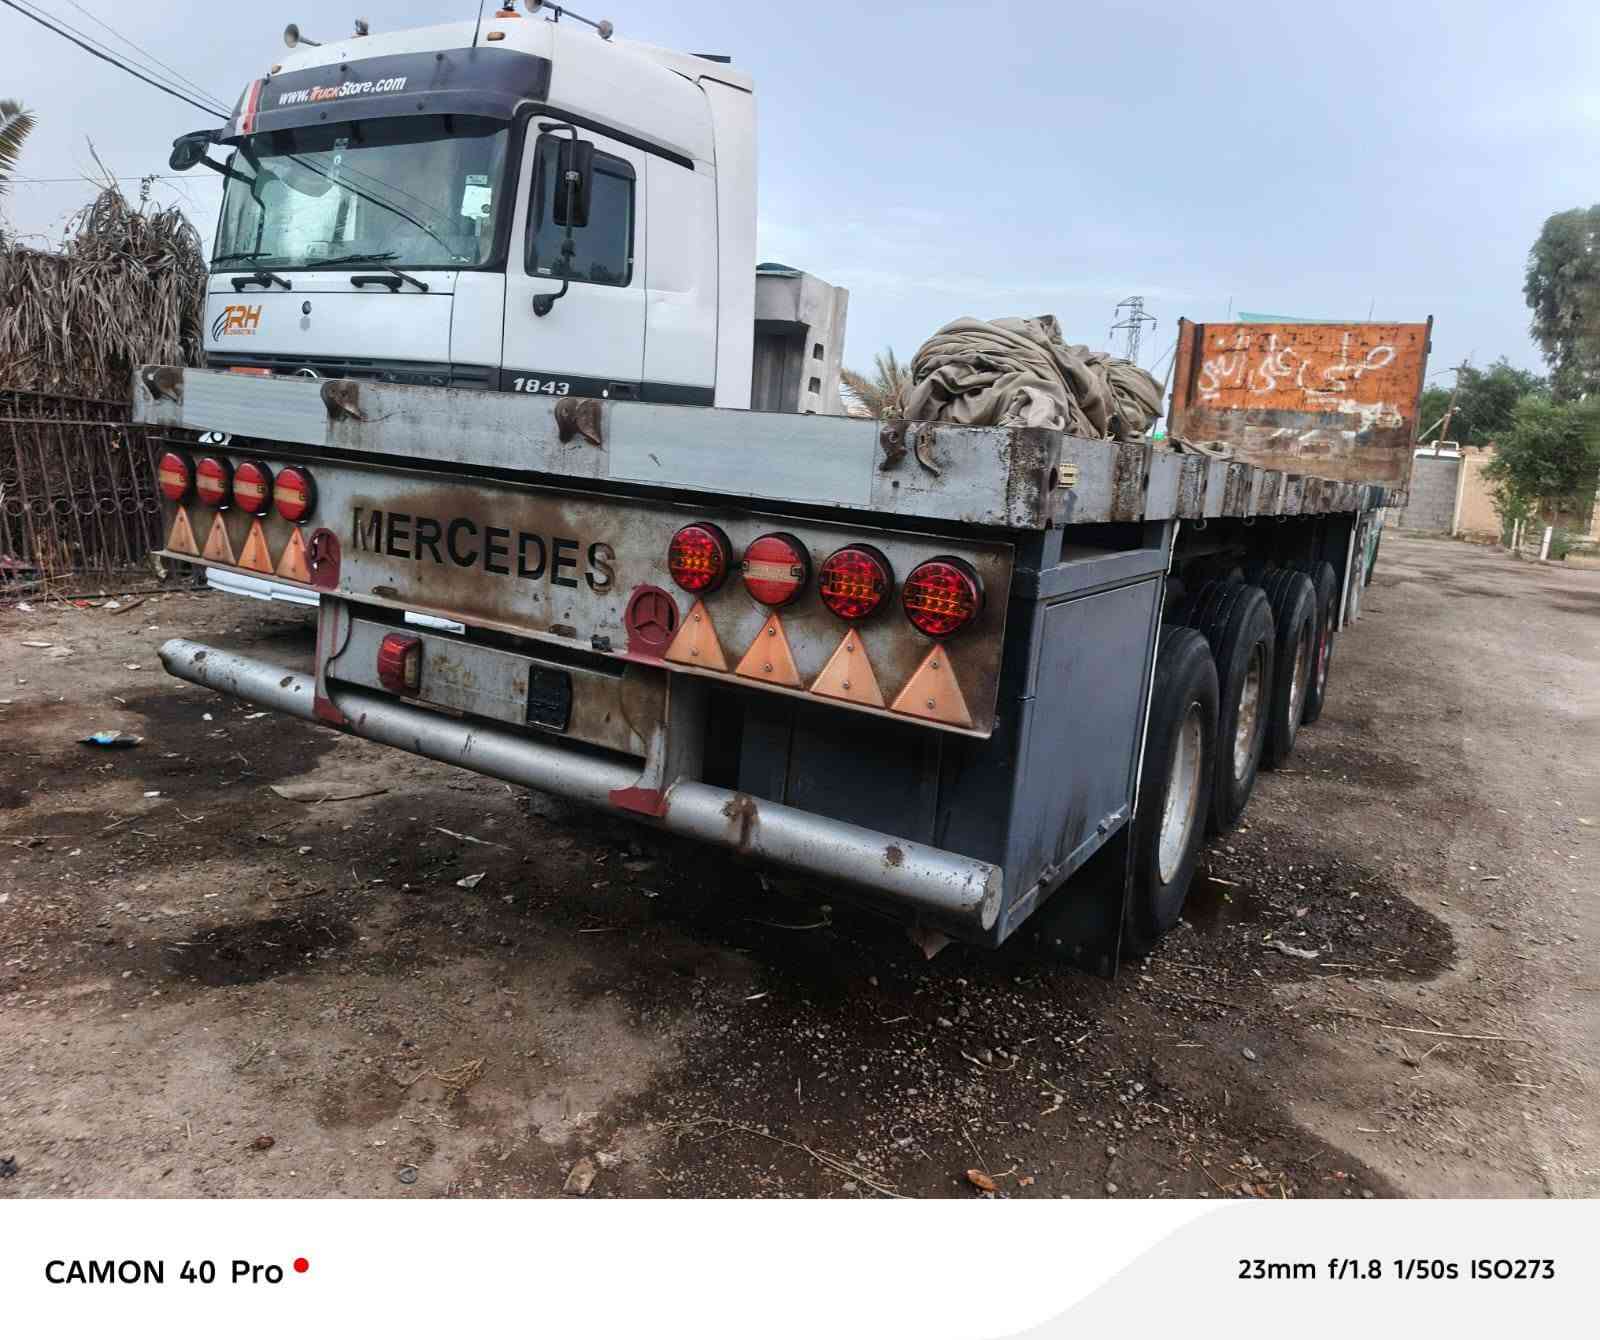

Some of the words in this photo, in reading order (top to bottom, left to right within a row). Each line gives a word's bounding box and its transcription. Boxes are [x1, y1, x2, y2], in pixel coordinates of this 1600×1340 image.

[278, 75, 408, 105] www.TruckStore.com
[513, 377, 570, 396] 1843
[351, 505, 616, 596] MERCEDES
